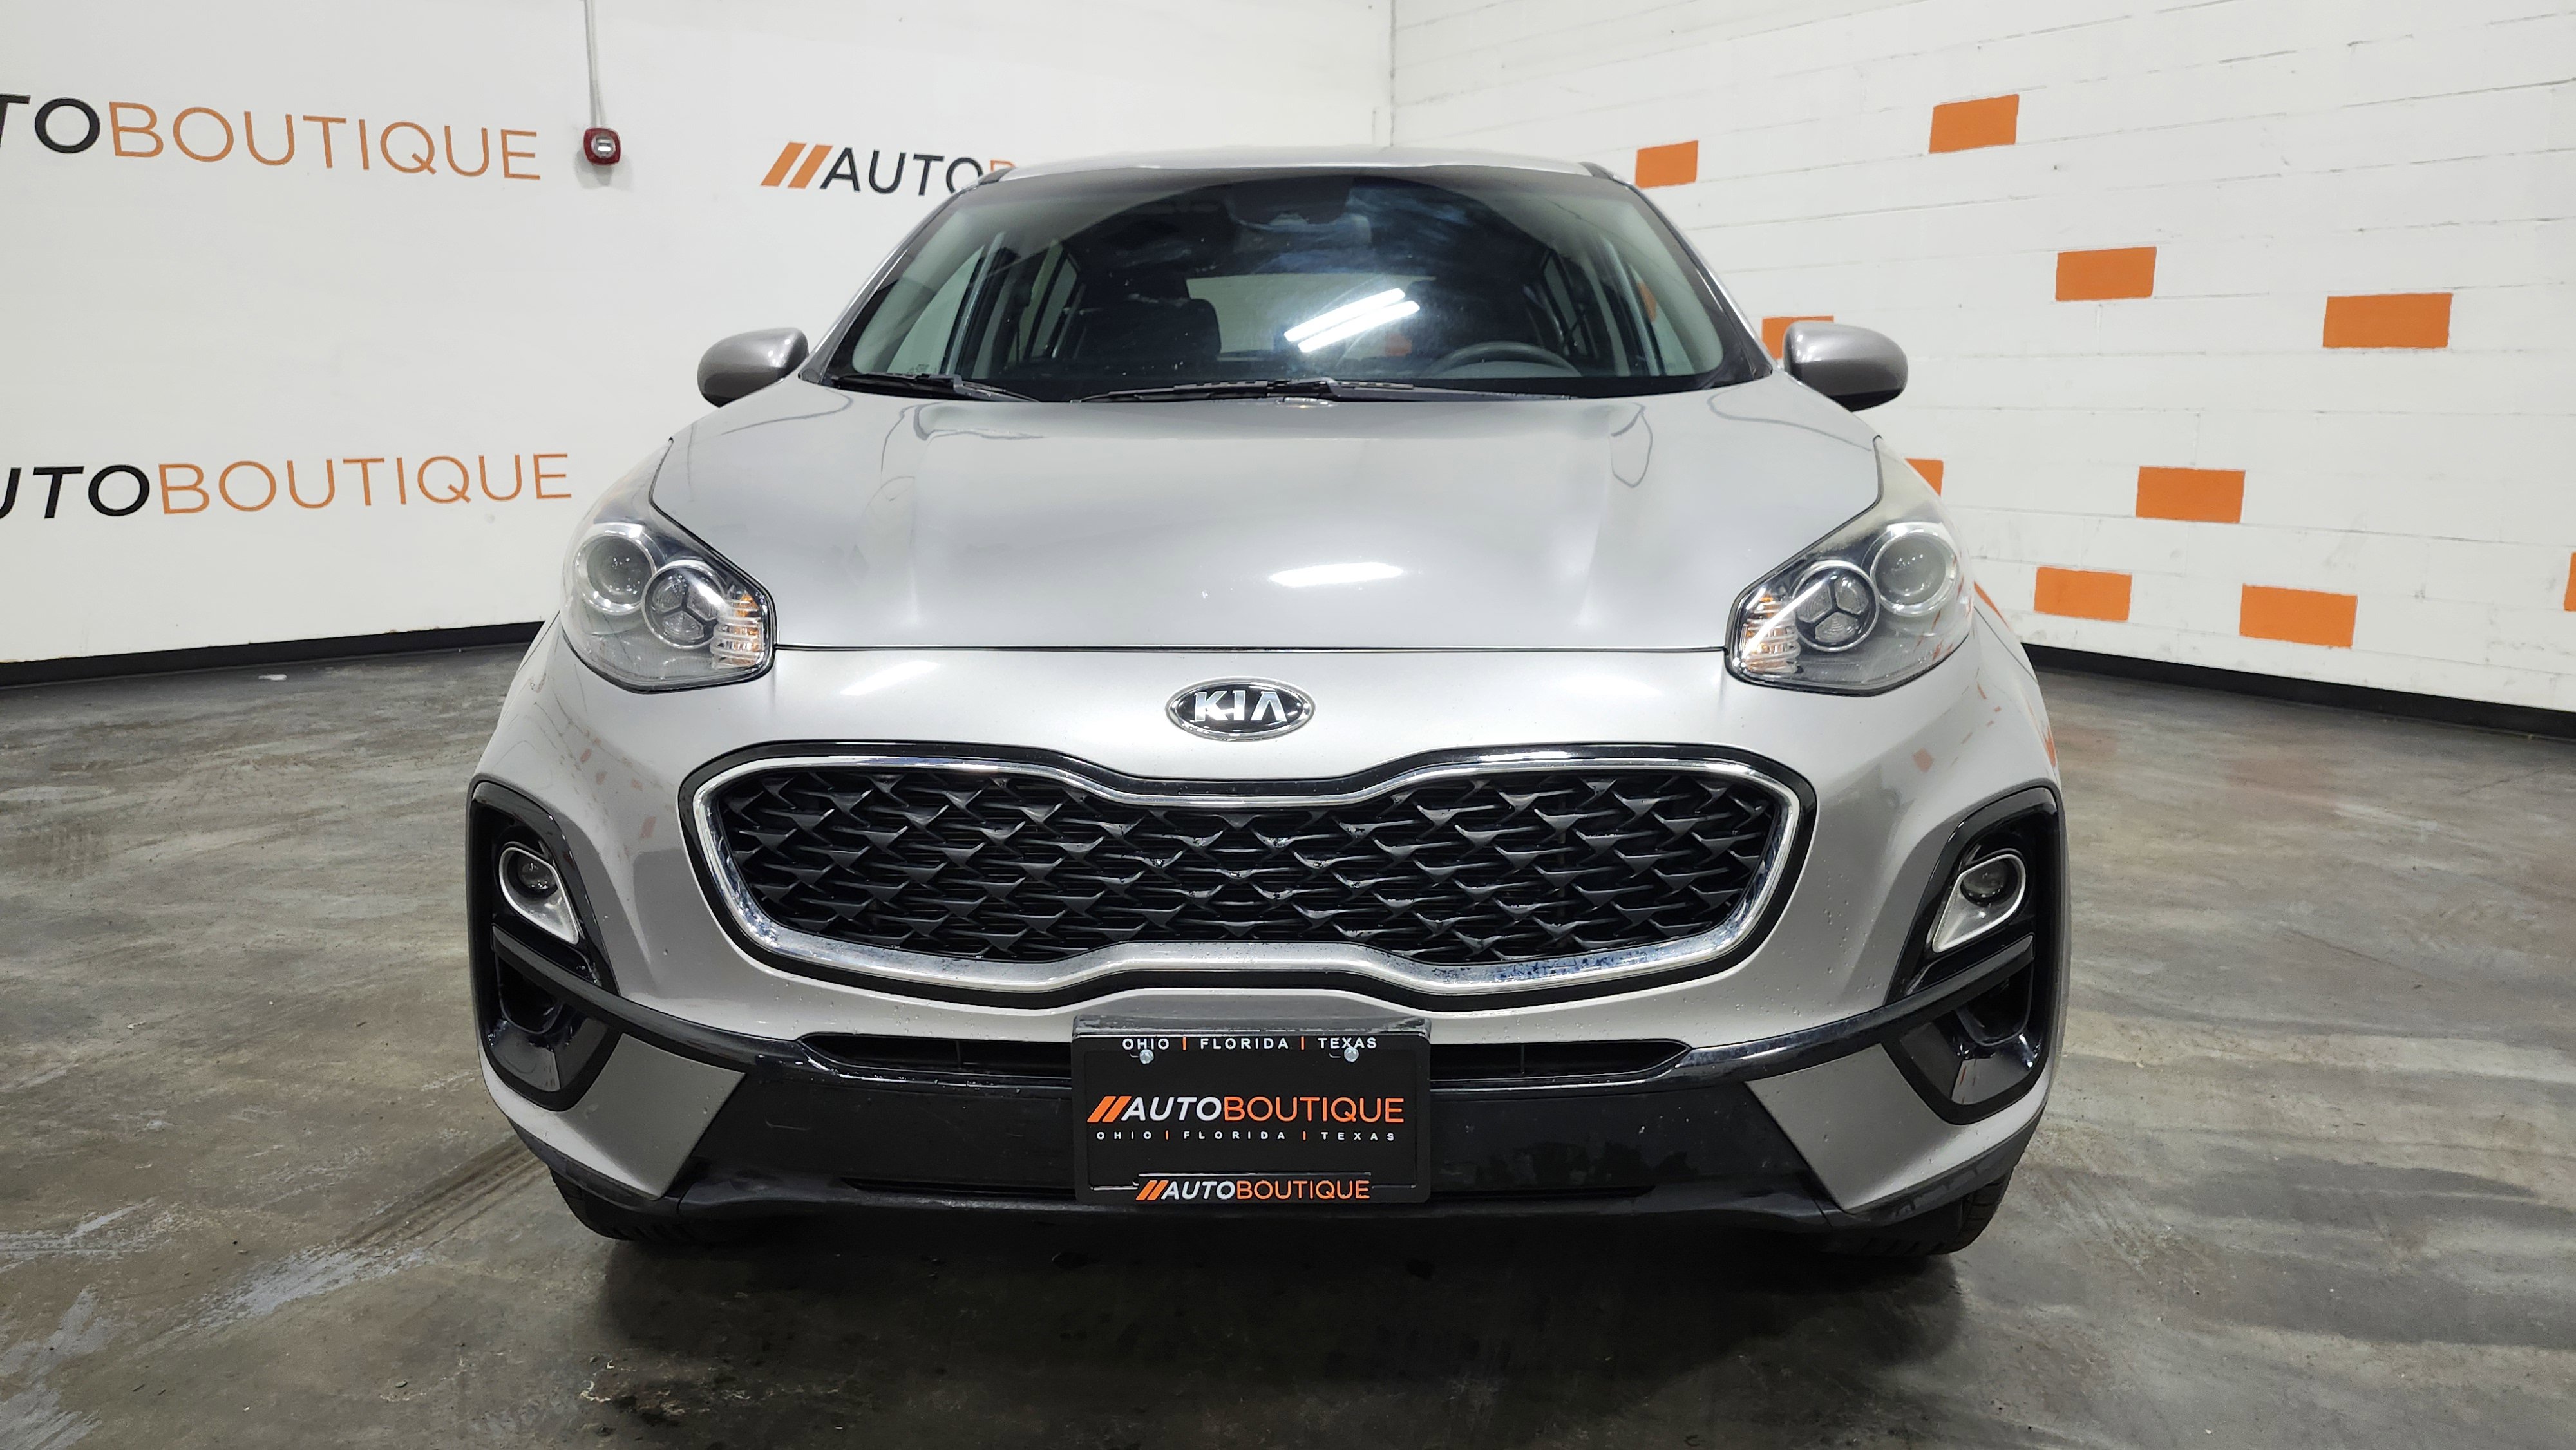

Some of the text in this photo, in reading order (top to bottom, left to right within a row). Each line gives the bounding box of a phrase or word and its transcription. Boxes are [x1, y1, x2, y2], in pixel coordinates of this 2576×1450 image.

[819, 147, 1016, 196] AUTO
[1195, 690, 1287, 722] KIA
[1122, 1036, 1377, 1050] OHIO FLORIDA TEXAS
[1121, 1096, 1405, 1123] AUTOBOUTIQUE
[1096, 1131, 1395, 1142] OHIO FLORIDA TEXAS
[1160, 1180, 1370, 1200] AUTOBOUTIQUE
